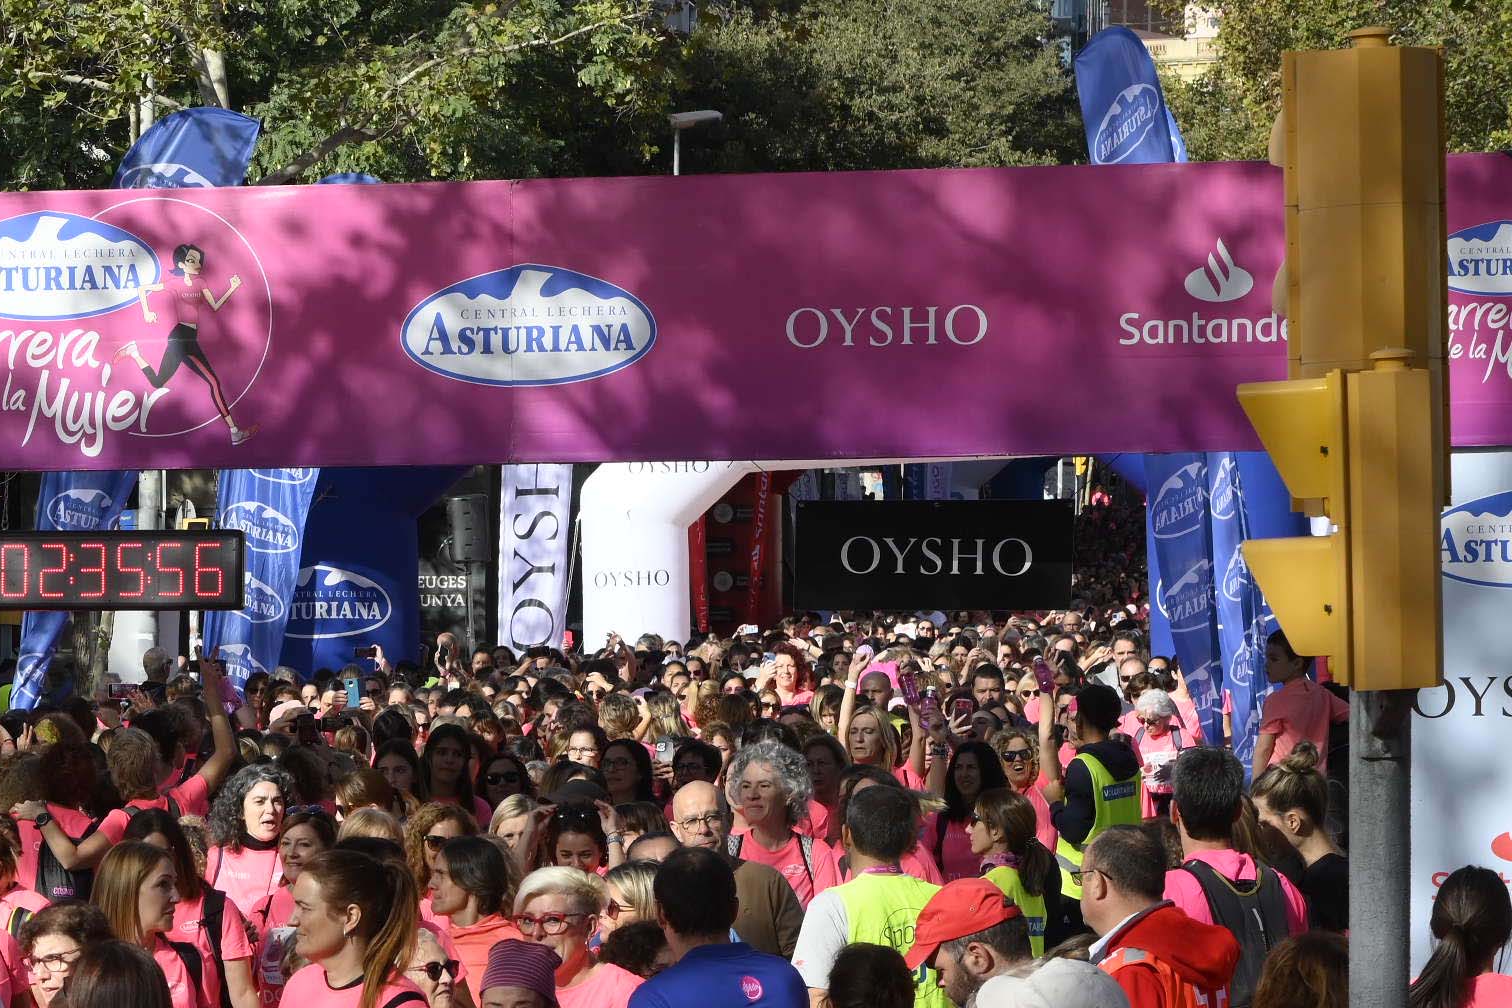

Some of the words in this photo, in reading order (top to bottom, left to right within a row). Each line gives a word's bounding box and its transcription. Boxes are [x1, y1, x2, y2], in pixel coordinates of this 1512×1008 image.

[64, 247, 137, 259] LECHERA
[460, 307, 538, 320] CENTRAL
[546, 305, 628, 318] LECHERA
[786, 304, 989, 349] OYSHO
[1448, 302, 1512, 331] arre
[421, 311, 637, 356] ASTURIANA
[1119, 312, 1287, 345] Santand
[1468, 332, 1487, 359] la
[1, 373, 27, 412] la
[21, 364, 171, 458] Mujer
[0, 543, 223, 597] 02:35:56
[510, 464, 560, 650] OYSH
[840, 536, 1033, 577] OYSHO
[418, 576, 467, 589] EUGES
[595, 569, 670, 588] OYSHO
[289, 601, 383, 620] TURIANA
[420, 594, 466, 608] UNYA
